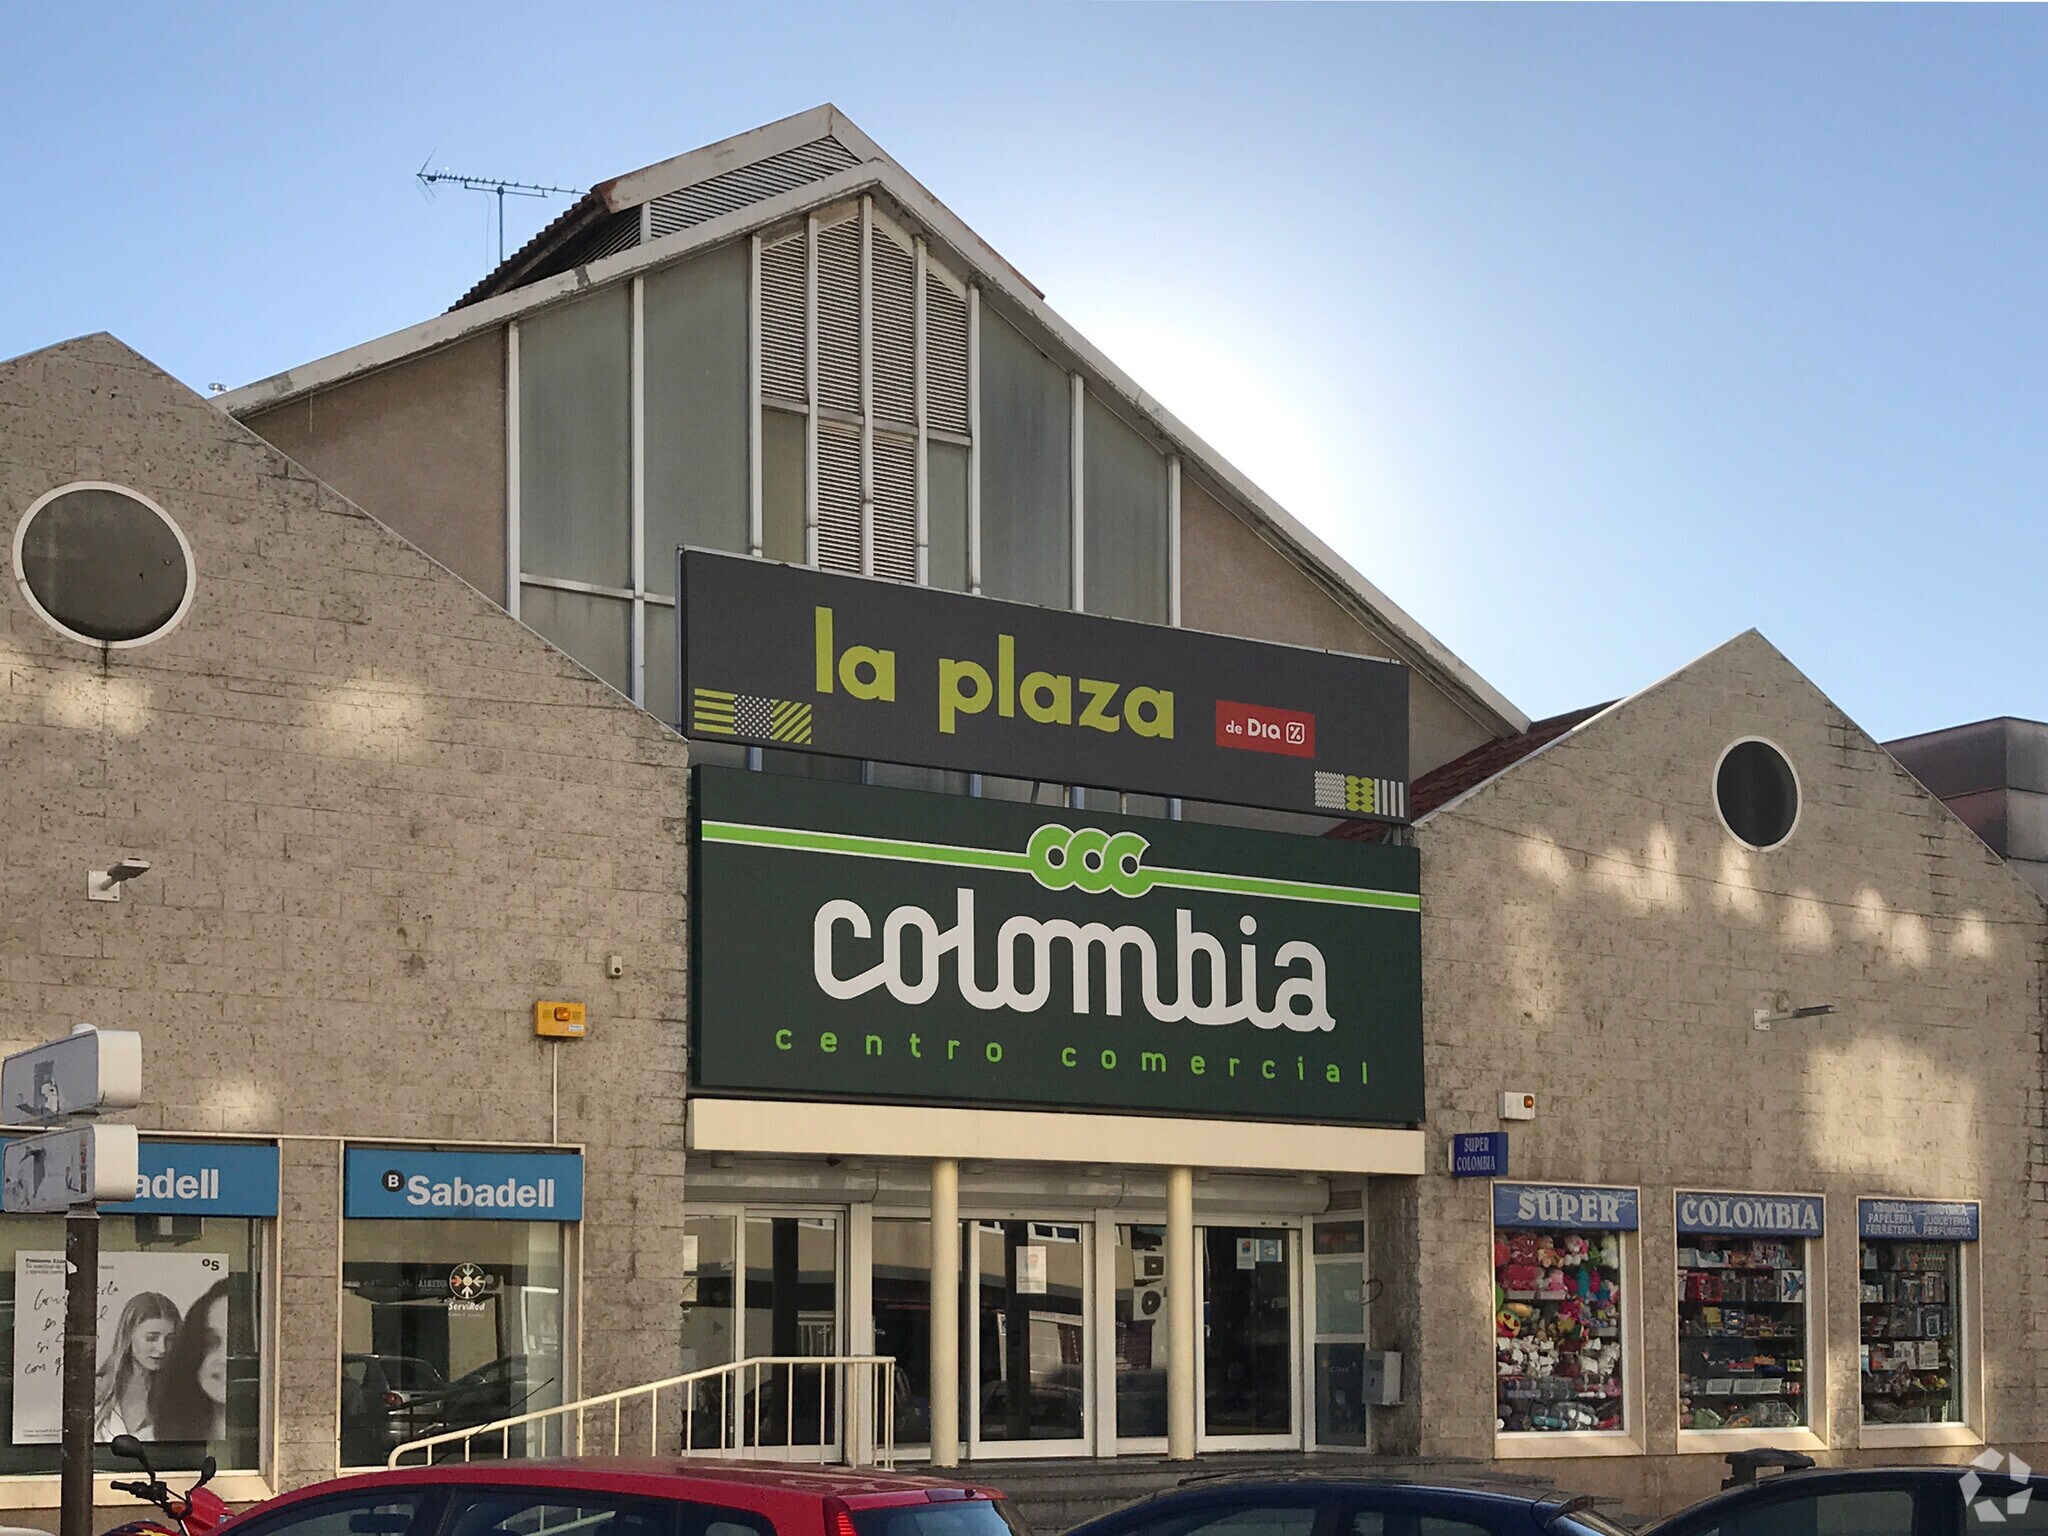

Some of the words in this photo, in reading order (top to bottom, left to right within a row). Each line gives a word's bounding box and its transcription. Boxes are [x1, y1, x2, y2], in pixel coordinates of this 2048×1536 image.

[815, 606, 896, 704] la
[938, 633, 1175, 740] plaza
[1225, 720, 1243, 735] de
[813, 887, 1337, 1033] colombia
[774, 1028, 1003, 1063] centro
[1060, 1046, 1369, 1085] comercial
[1464, 1136, 1490, 1152] SUPER
[1456, 1155, 1496, 1171] COLOMBIA
[134, 1167, 219, 1199] adell
[388, 1174, 400, 1188] B
[406, 1175, 555, 1208] Sabadell
[1517, 1190, 1621, 1223] SUPER
[1681, 1198, 1819, 1231] COLOMBIA
